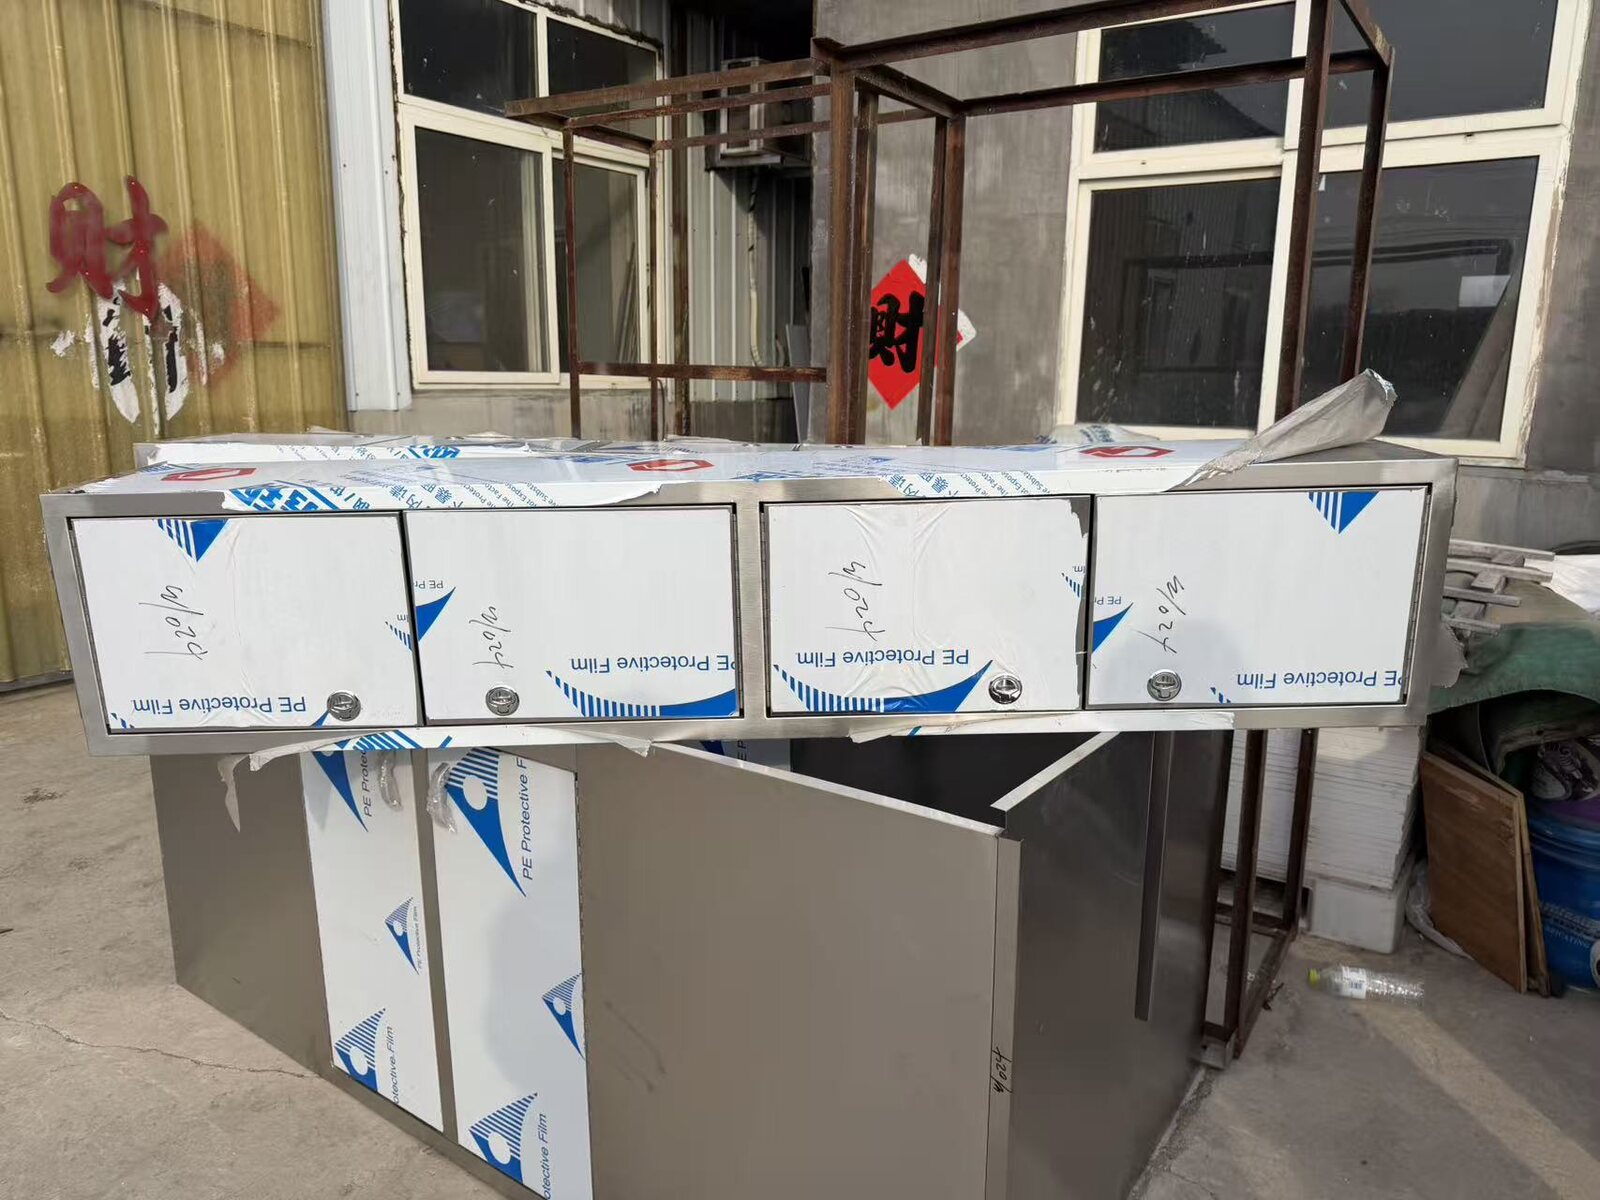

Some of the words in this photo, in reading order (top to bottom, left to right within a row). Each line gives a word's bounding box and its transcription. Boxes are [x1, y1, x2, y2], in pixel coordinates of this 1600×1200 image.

[429, 579, 444, 589] PE
[1106, 595, 1121, 605] PE
[617, 655, 709, 672] Protective
[843, 649, 935, 666] Protective
[942, 649, 969, 664] PE
[1284, 671, 1377, 688] Protective
[179, 696, 272, 714] Protective
[278, 696, 306, 713] PE
[362, 795, 373, 818] PE
[518, 774, 531, 853] Protective
[521, 856, 533, 881] PE
[386, 1026, 395, 1053] Film
[389, 1055, 400, 1104] otective
[537, 1113, 548, 1144] Film
[540, 1147, 551, 1200] otective
